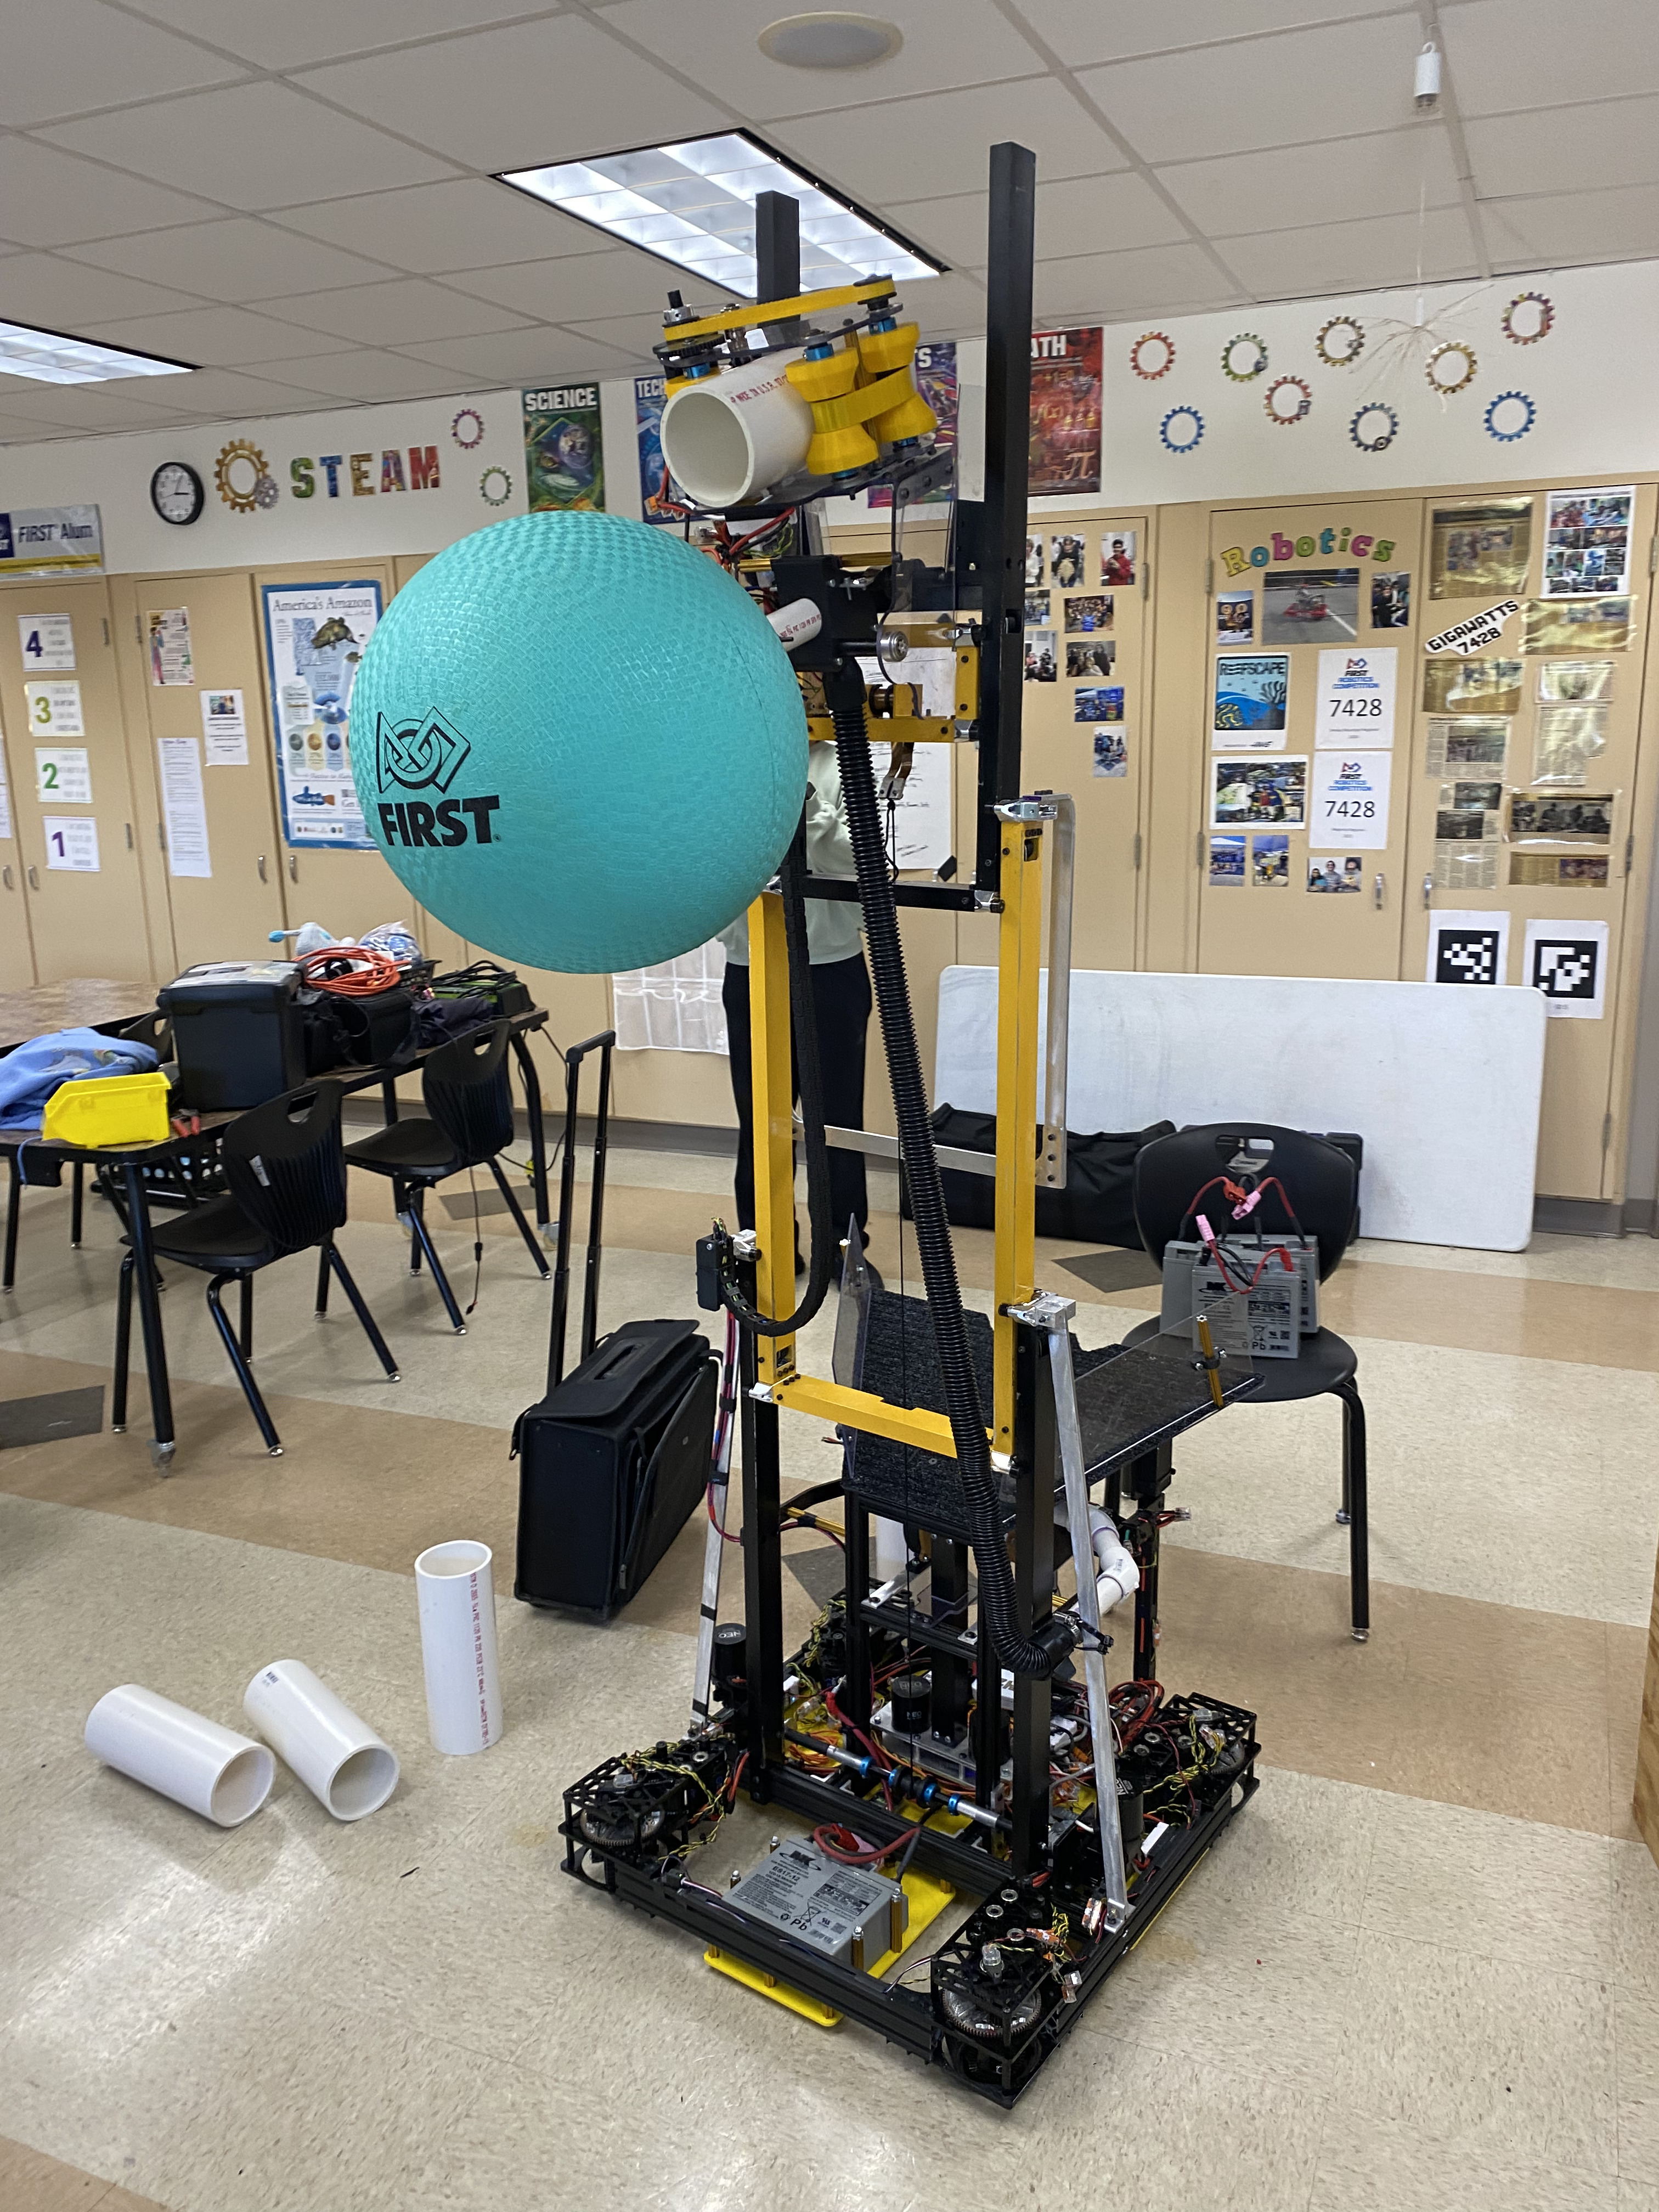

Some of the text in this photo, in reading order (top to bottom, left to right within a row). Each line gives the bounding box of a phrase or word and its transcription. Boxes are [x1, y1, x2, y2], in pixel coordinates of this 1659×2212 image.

[524, 386, 597, 411] SCIENCE
[290, 444, 441, 498] STEAM
[18, 523, 56, 543] FIRST
[1220, 527, 1397, 577] Robotics
[273, 596, 373, 612] America's Amazon
[1427, 600, 1519, 651] GIGAWATTS
[26, 630, 43, 658] 4
[1457, 627, 1502, 654] 7428
[35, 696, 52, 724] 3
[1328, 698, 1383, 718] 7428
[42, 762, 60, 789] 2
[377, 794, 500, 847] FIRST
[1324, 800, 1375, 819] 7428
[52, 831, 65, 857] 1
[1251, 1341, 1267, 1350] Pb
[790, 1918, 808, 1931] Pb
